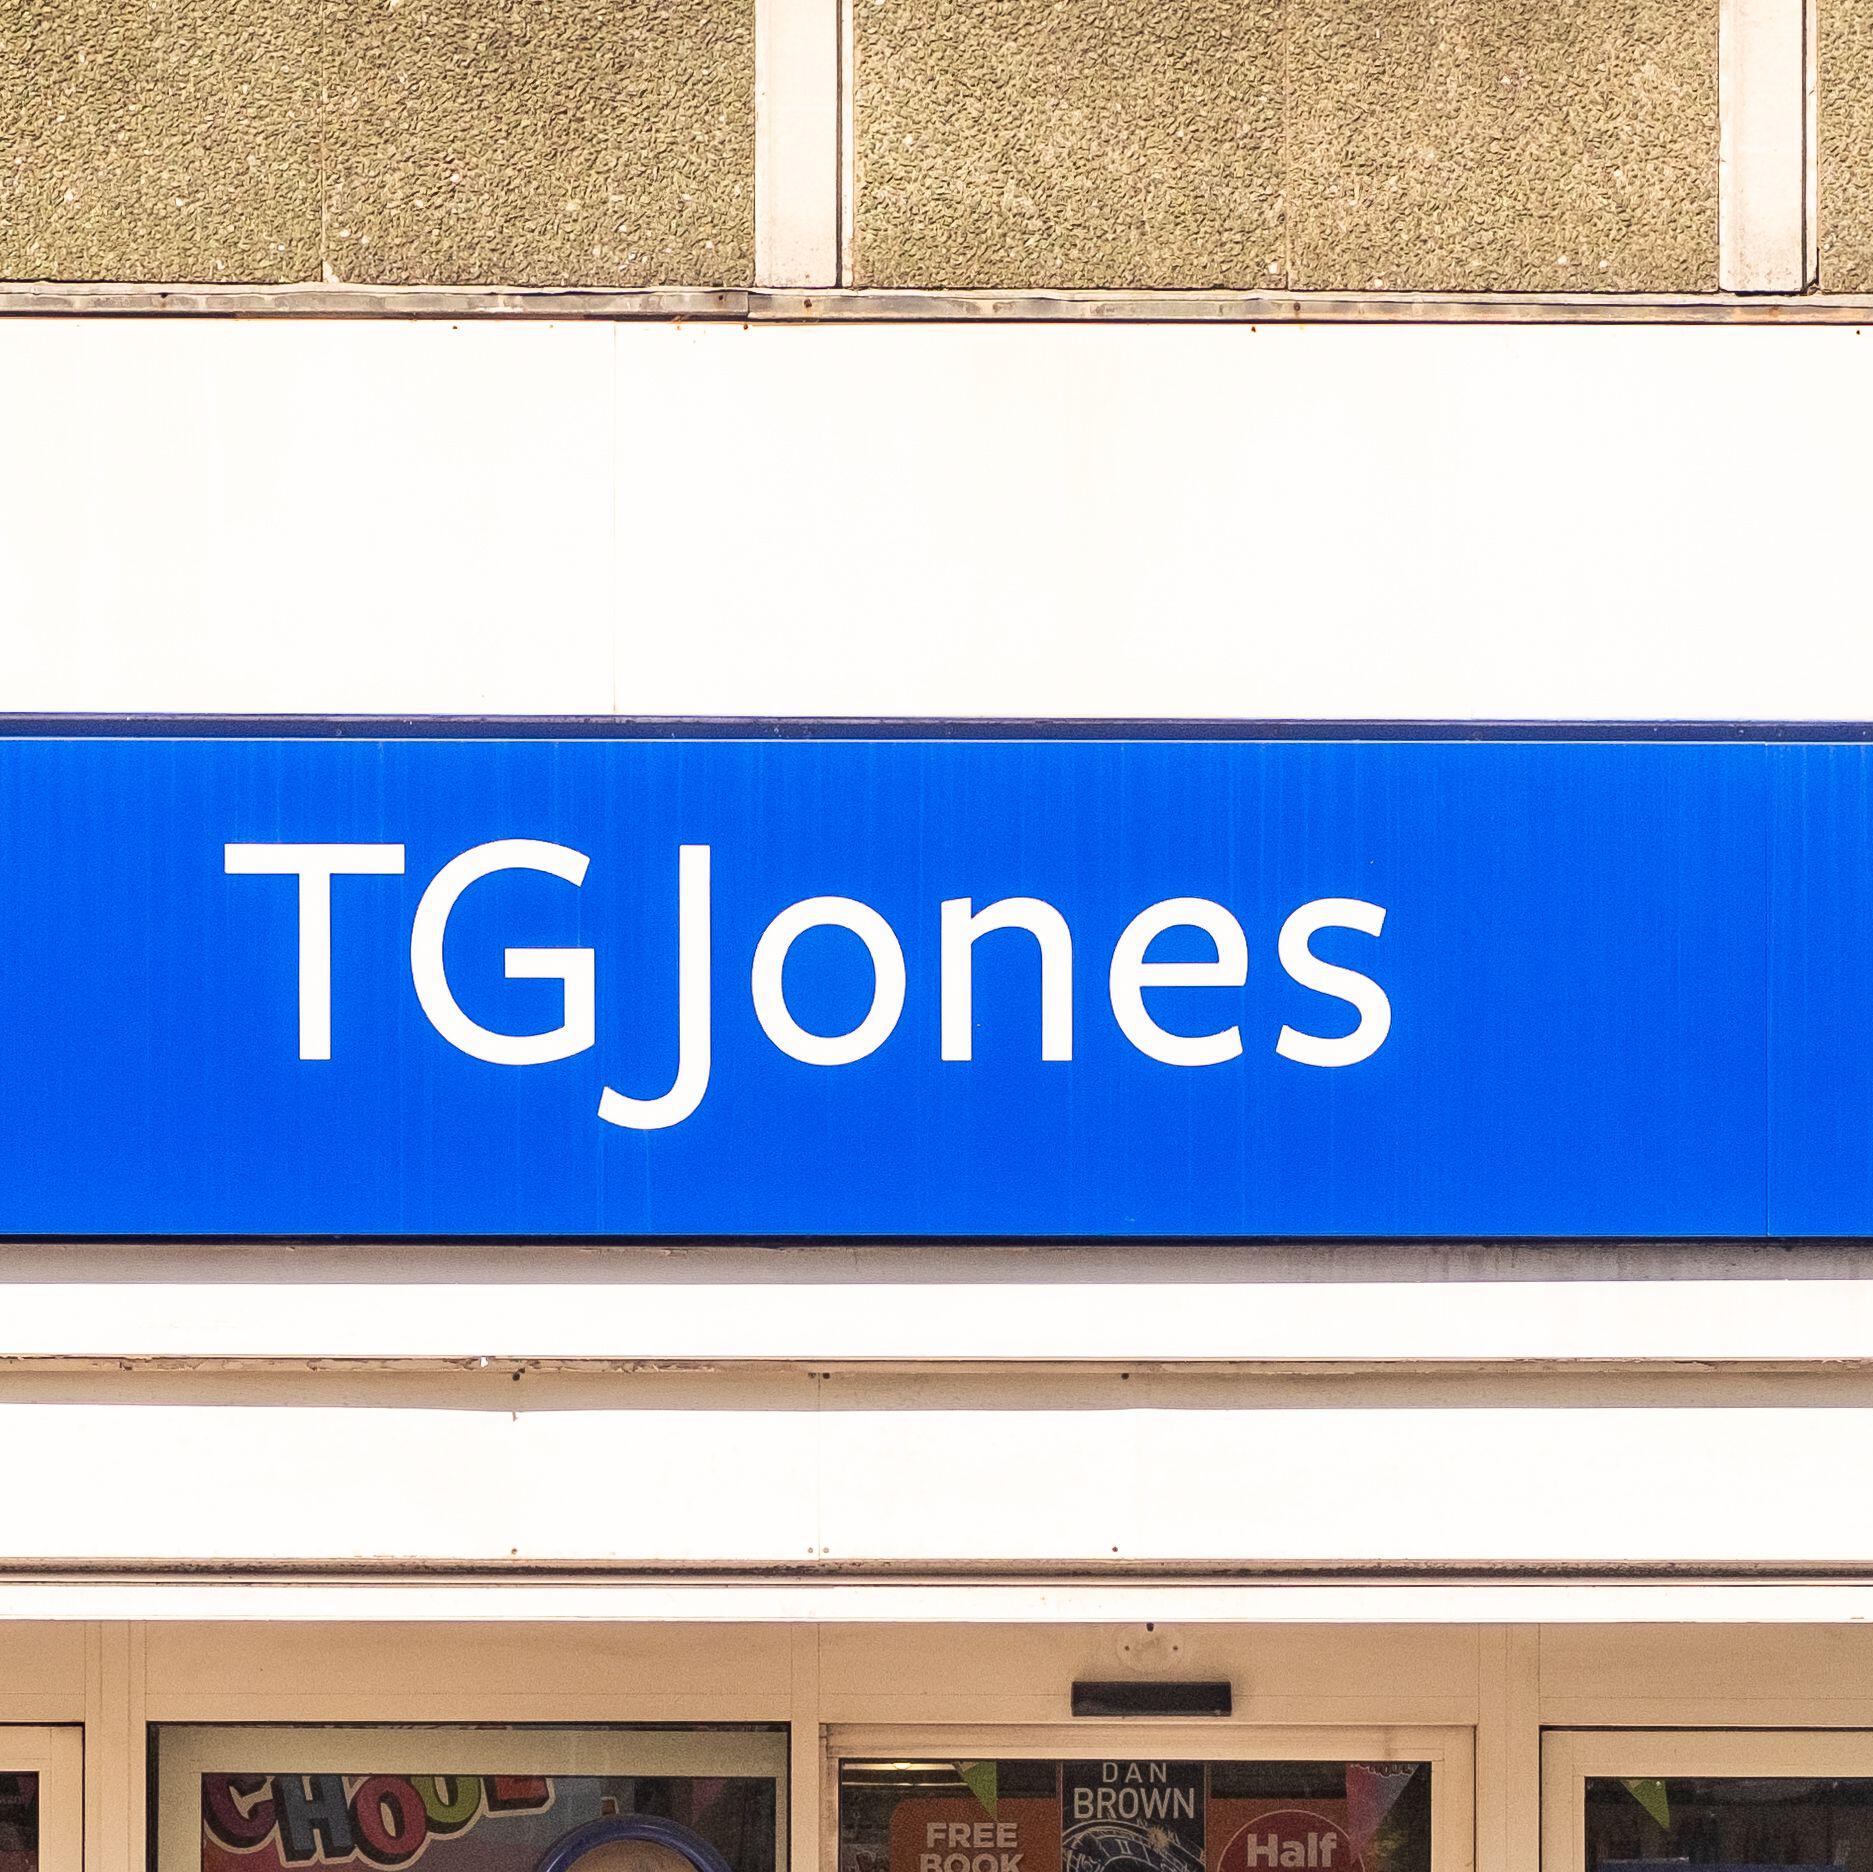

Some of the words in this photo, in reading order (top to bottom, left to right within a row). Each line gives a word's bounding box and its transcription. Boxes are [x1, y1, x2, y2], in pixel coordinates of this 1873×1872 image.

[1102, 1761, 1168, 1783] DAN
[1073, 1786, 1195, 1820] BROWN
[926, 1822, 1018, 1849] FREE
[1246, 1832, 1337, 1867] Half
